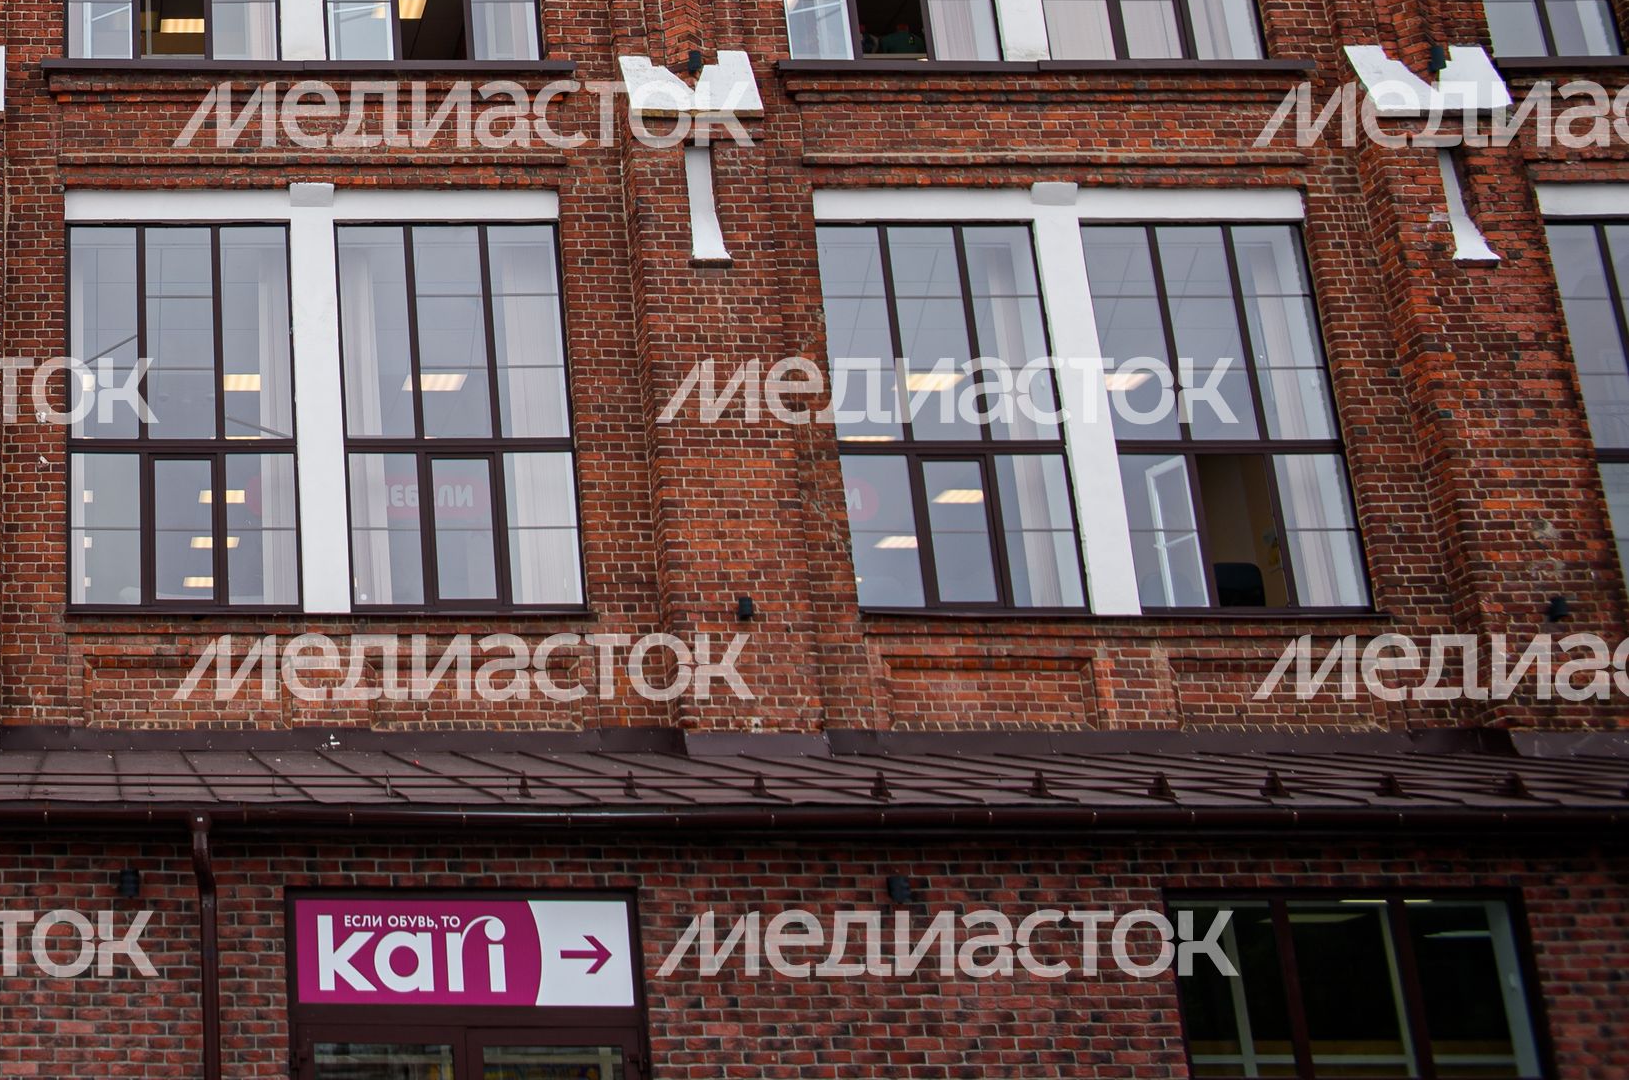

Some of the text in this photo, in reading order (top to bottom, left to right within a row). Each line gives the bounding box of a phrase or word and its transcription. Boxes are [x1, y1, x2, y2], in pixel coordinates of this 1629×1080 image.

[344, 914, 461, 930] ЕСЛИ ОБУВЬ, ТО
[317, 914, 507, 993] kari
